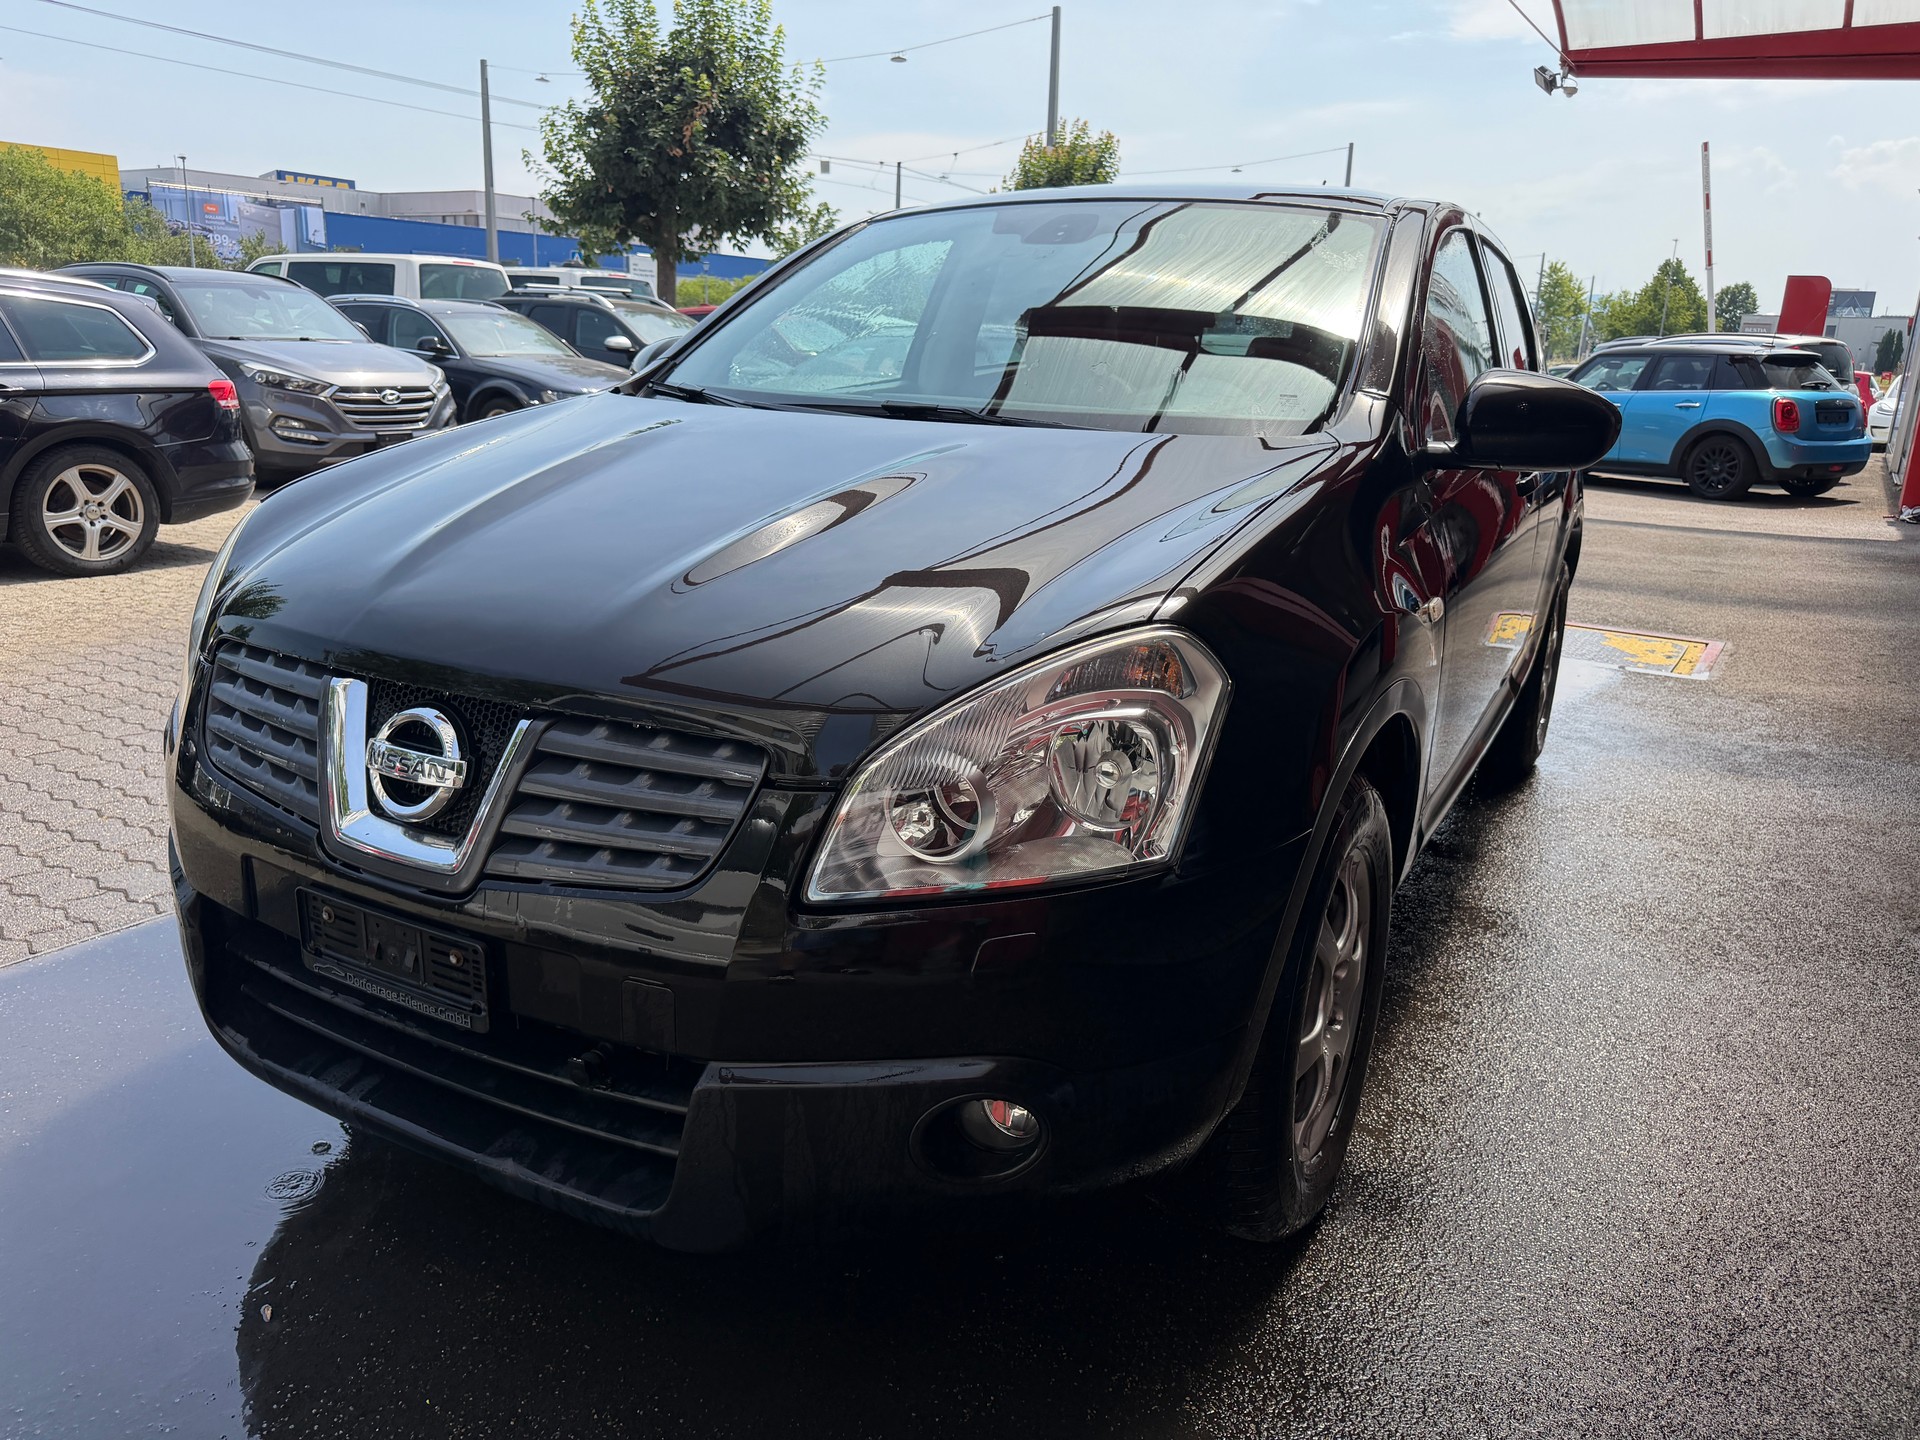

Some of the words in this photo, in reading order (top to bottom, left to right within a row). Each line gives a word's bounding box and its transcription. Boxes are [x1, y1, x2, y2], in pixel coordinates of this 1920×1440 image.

[368, 747, 447, 781] NISSAN
[346, 972, 397, 1001] Dorfgarage
[400, 993, 436, 1015] Etienne
[438, 1007, 472, 1028] GmbH
